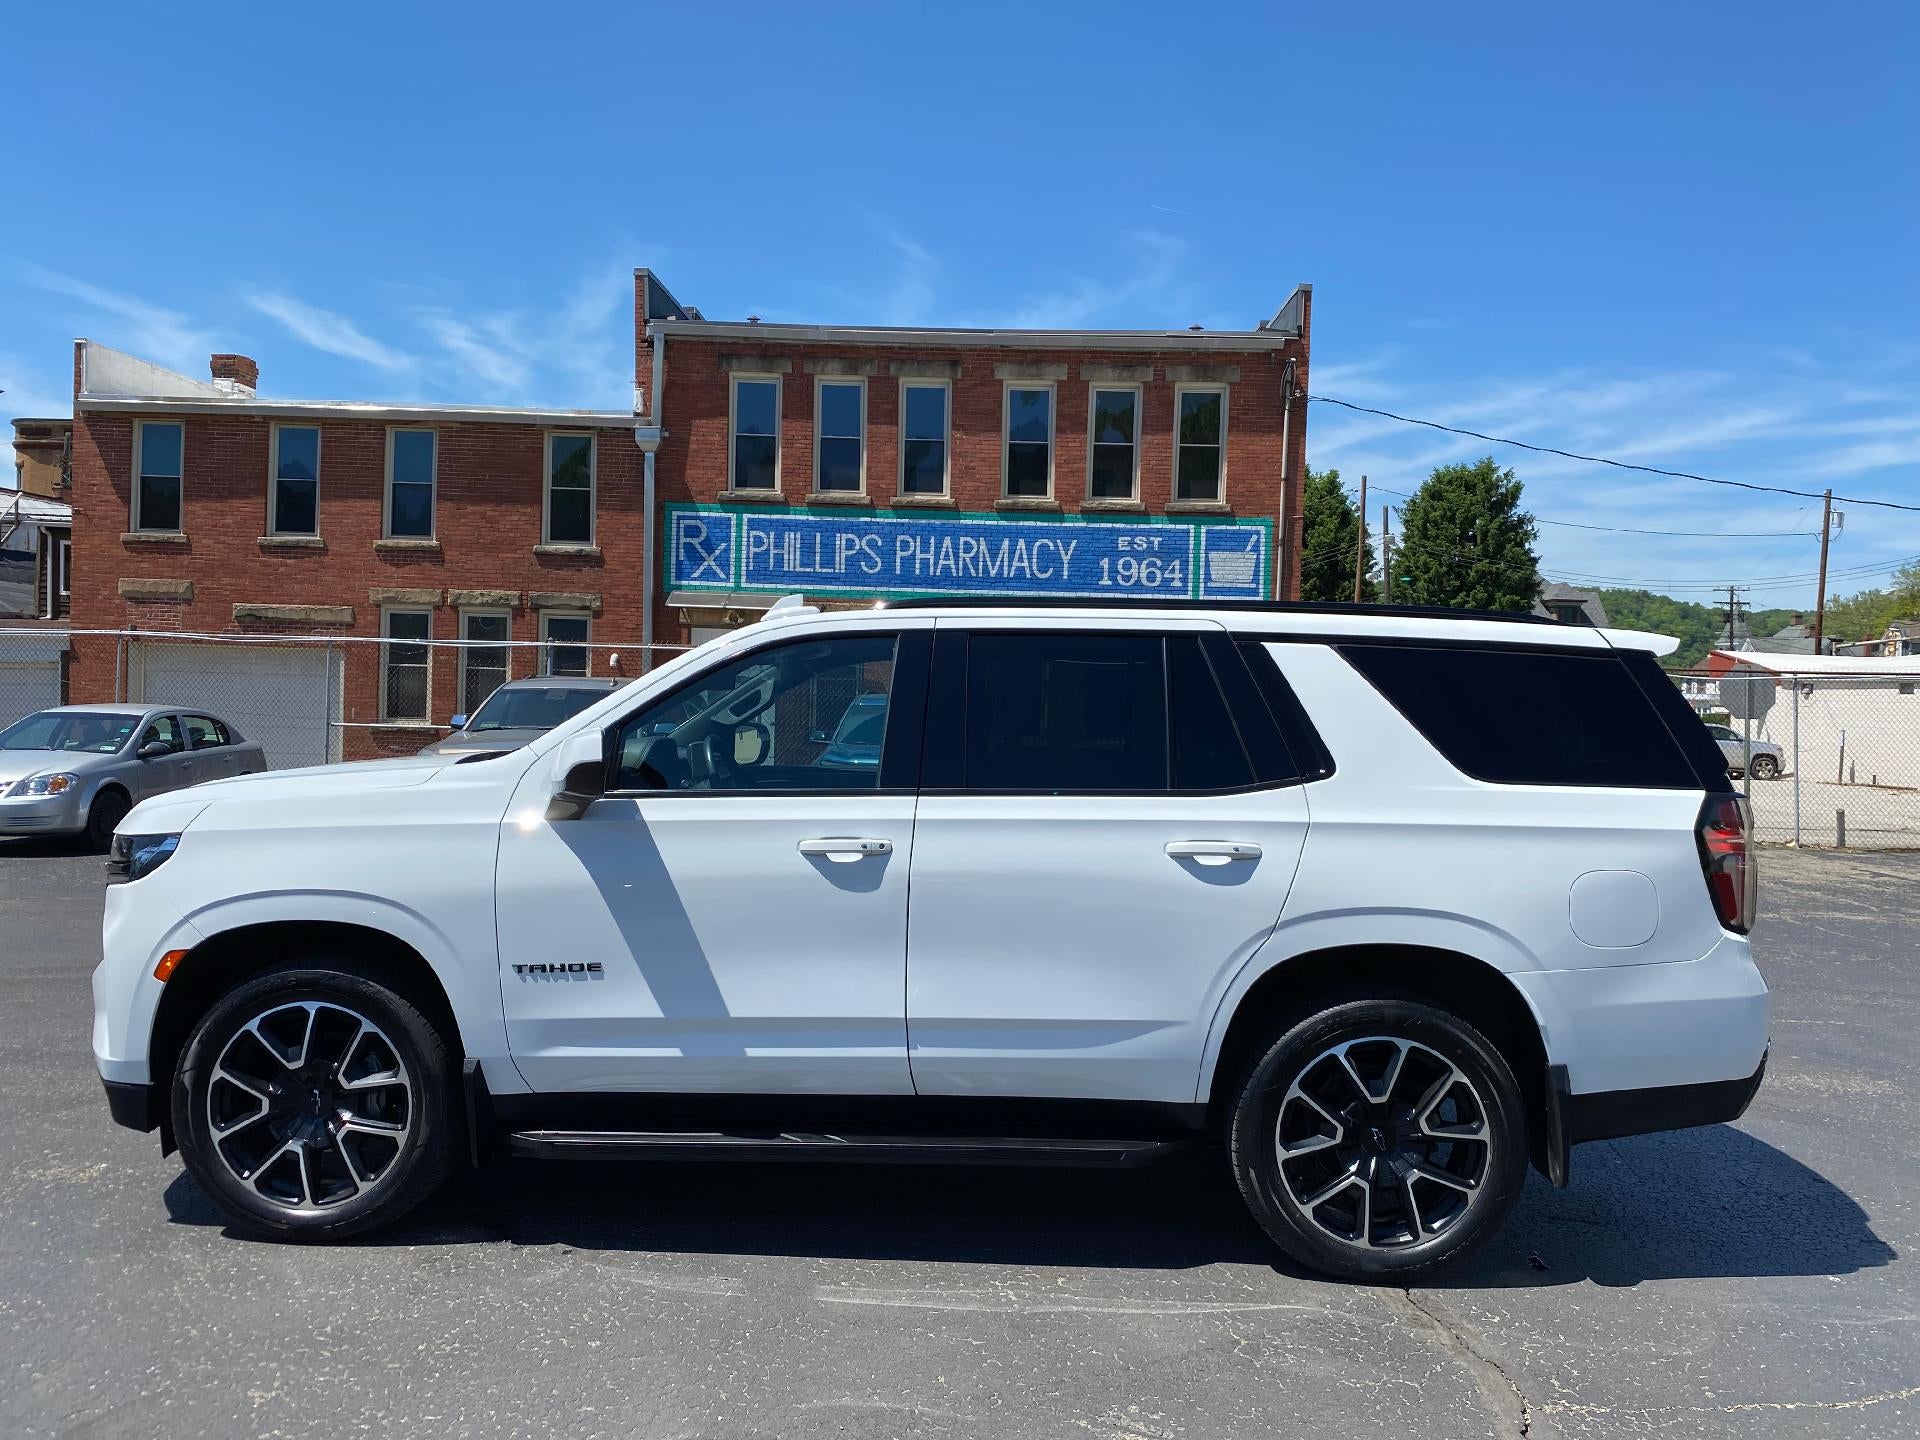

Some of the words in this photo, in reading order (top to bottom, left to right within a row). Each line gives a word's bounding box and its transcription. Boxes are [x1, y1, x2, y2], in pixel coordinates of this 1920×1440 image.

[1117, 536, 1163, 551] EST
[749, 530, 882, 574] PHILLIPS
[895, 535, 1078, 580] PHARMACY
[1098, 557, 1183, 587] 1964
[511, 962, 603, 974] TAHOE
